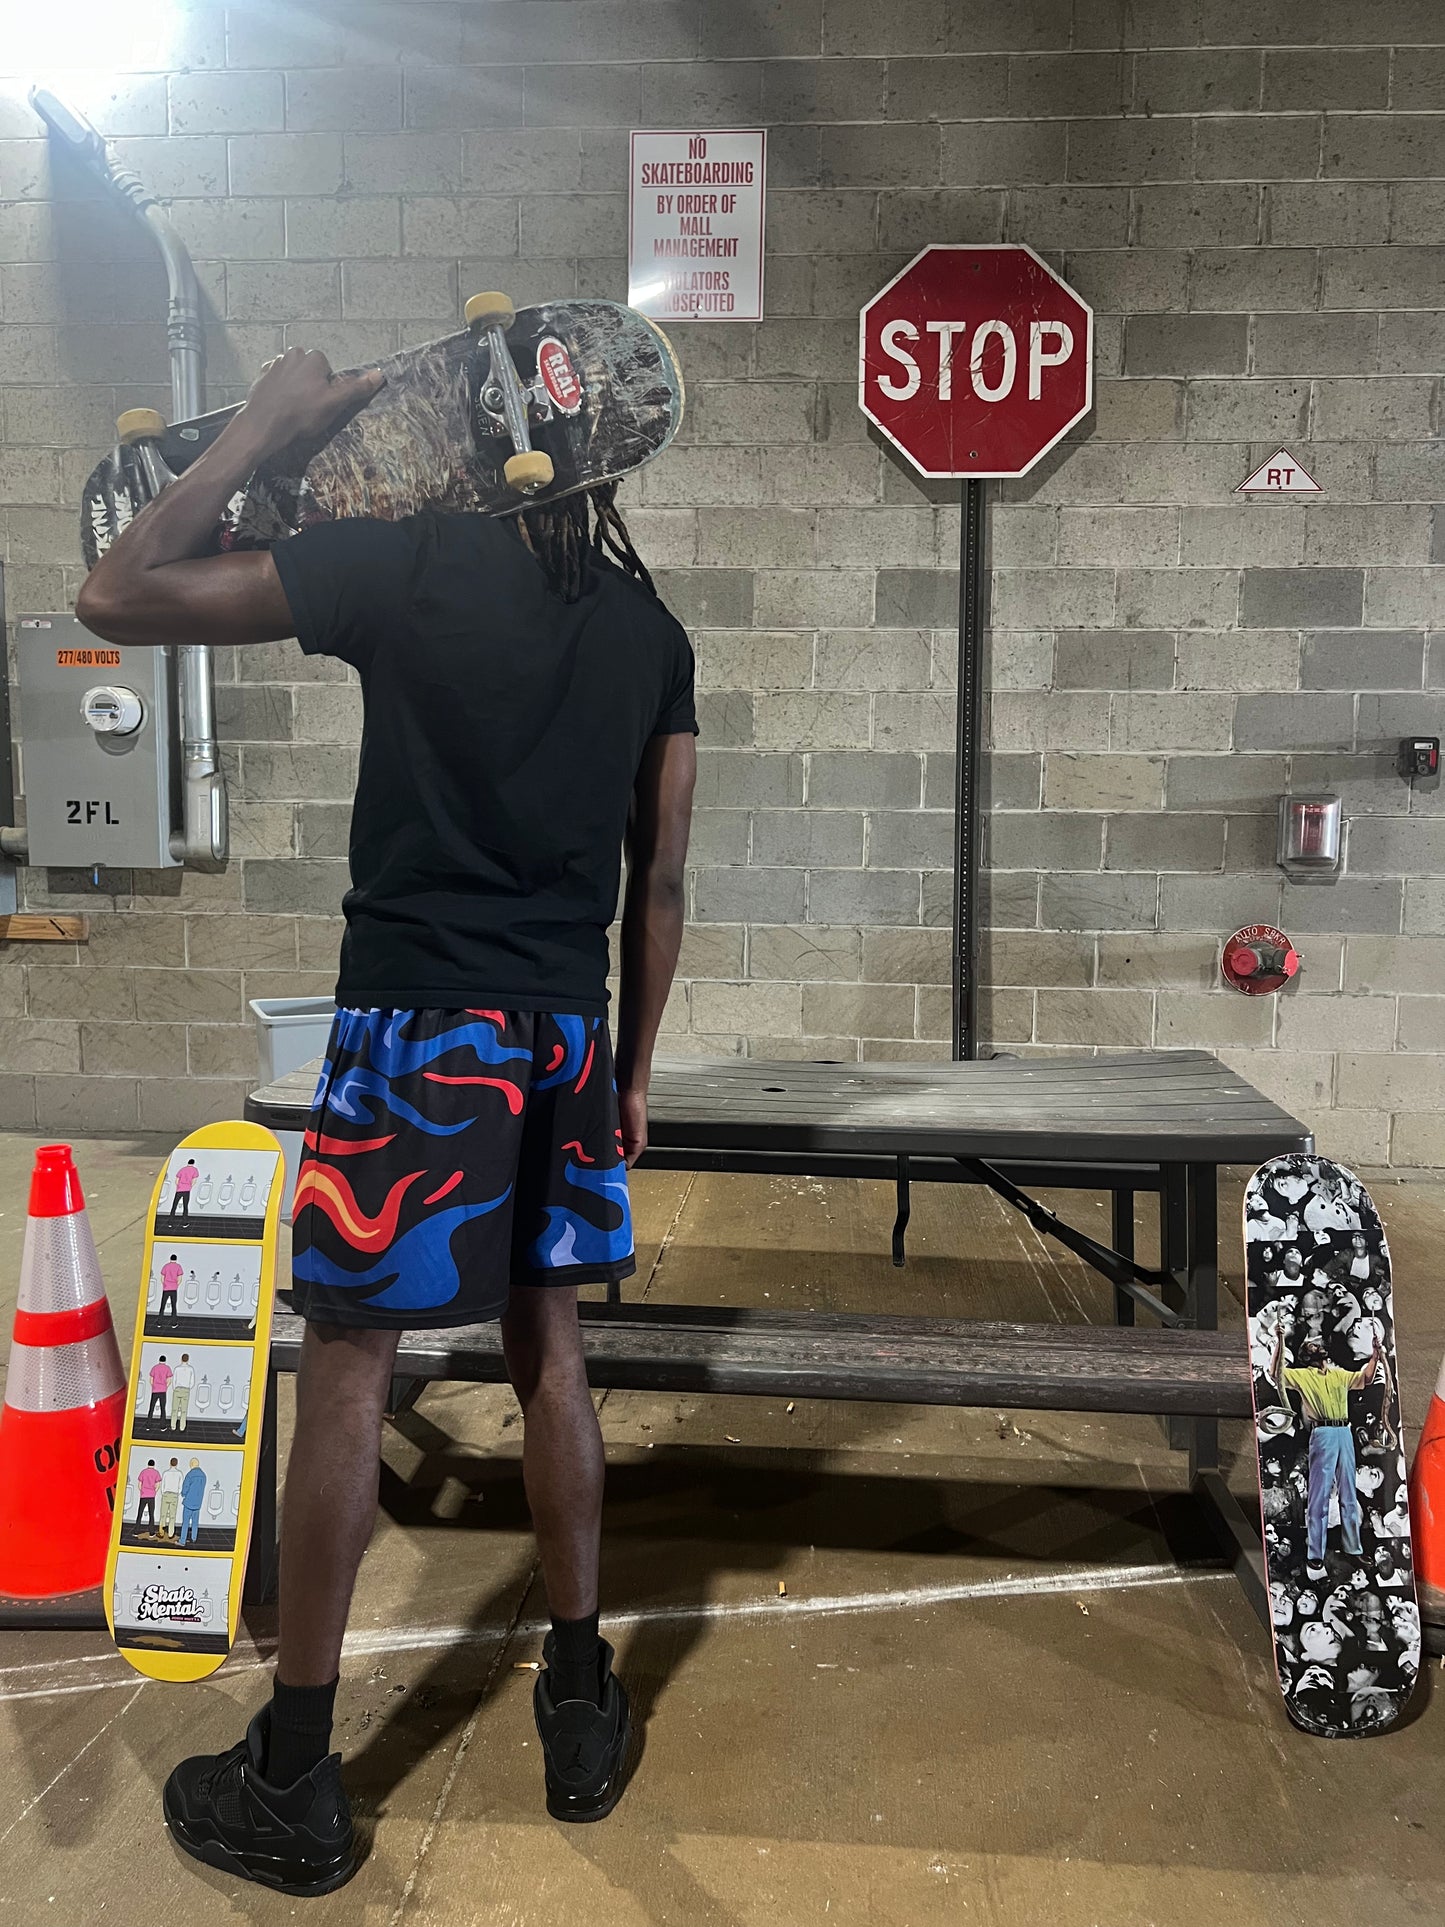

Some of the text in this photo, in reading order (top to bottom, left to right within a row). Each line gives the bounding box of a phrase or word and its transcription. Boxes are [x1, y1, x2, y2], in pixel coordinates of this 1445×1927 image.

[688, 138, 707, 160] NO
[641, 162, 754, 185] SKATEBOARDING
[657, 194, 737, 215] BY ORDER OF
[680, 217, 713, 236] MALL
[653, 238, 739, 258] MANAGEMENT
[658, 293, 735, 313] ROSECUTED
[877, 319, 1074, 402] STOP
[548, 352, 577, 398] REAL
[1267, 468, 1296, 486] RT
[58, 650, 120, 666] 277/480 VOLTS
[66, 800, 120, 825] 2FL
[1234, 926, 1258, 943] AUTO
[143, 1584, 195, 1604] Skate
[138, 1600, 205, 1620] Mental
